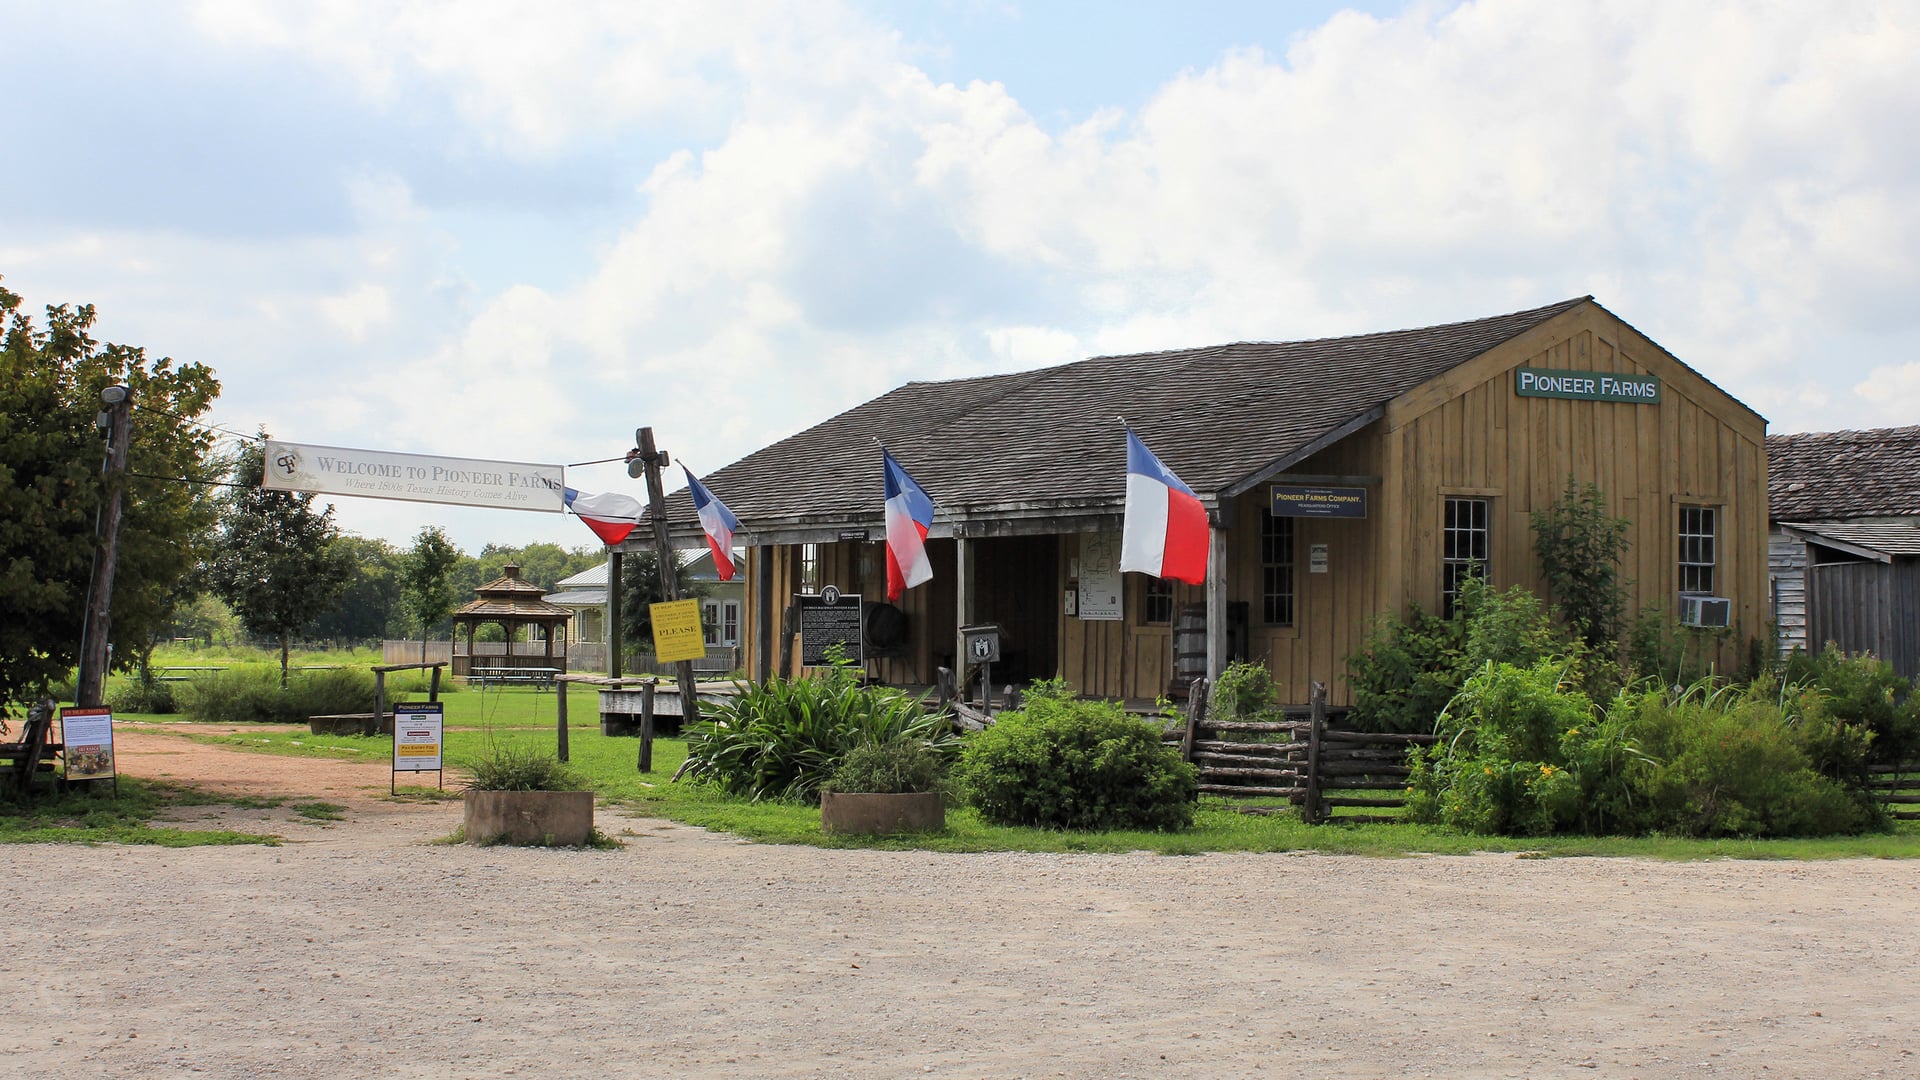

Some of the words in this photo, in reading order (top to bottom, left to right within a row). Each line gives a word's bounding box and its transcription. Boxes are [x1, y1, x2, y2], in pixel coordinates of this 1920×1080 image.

[1520, 372, 1595, 394] PIONEER
[1600, 377, 1656, 398] FARMS
[317, 456, 402, 479] WELCOME
[407, 466, 427, 480] TO
[431, 465, 504, 487] PIONEER
[508, 472, 562, 491] FARMS
[345, 478, 376, 490] Where
[407, 483, 434, 495] Texas
[436, 485, 471, 499] History
[473, 488, 501, 500] Comes
[504, 491, 528, 502] Alive
[1276, 493, 1304, 501] PIONEER
[1305, 494, 1328, 502] FARMS
[659, 626, 697, 637] PLEASE
